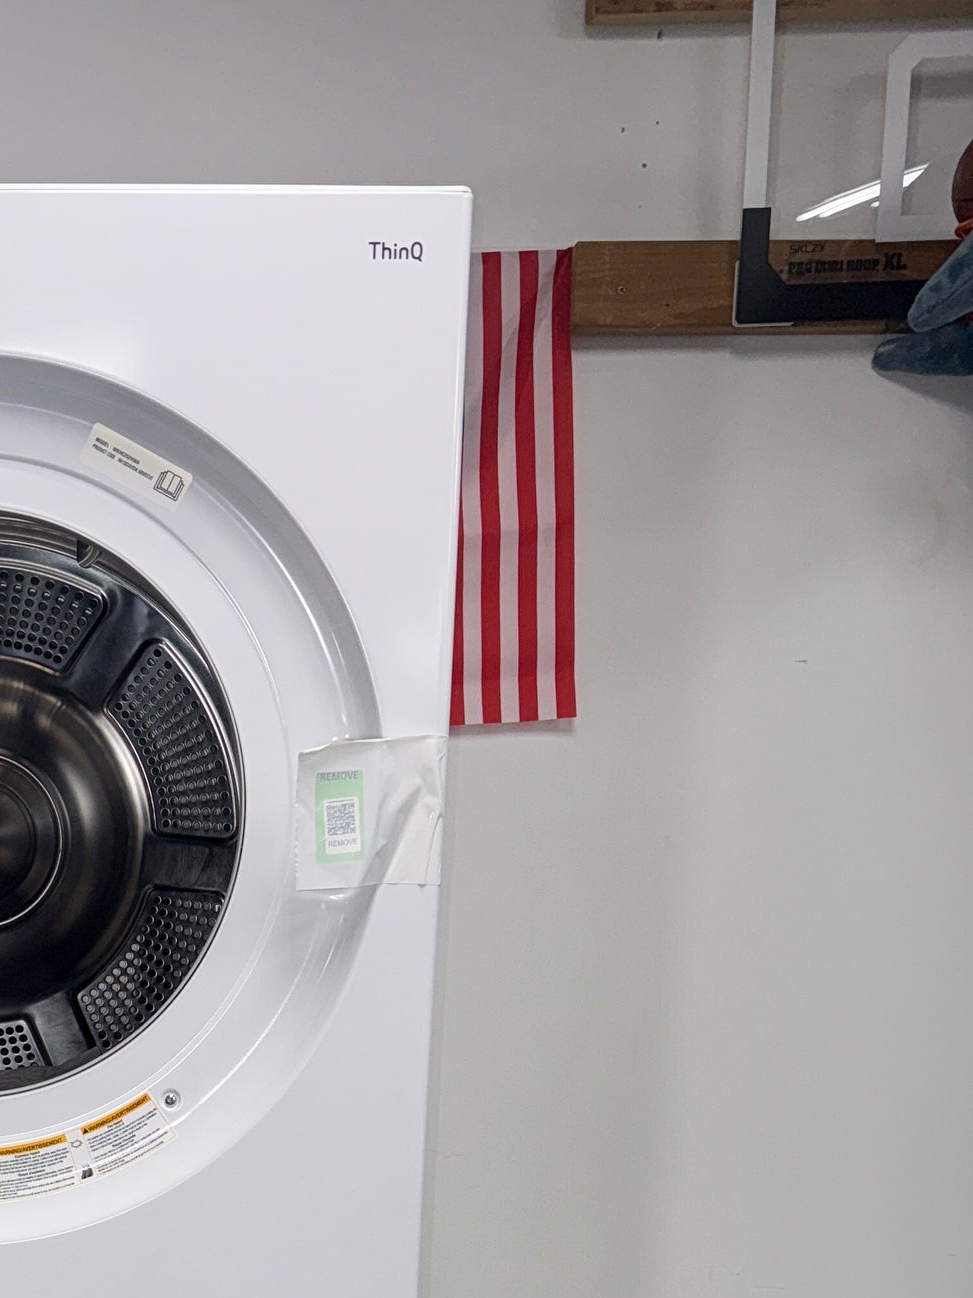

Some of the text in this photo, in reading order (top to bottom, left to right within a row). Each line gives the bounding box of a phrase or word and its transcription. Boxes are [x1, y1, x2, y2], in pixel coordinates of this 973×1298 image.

[368, 241, 424, 262] ThinQ
[882, 252, 908, 271] XL
[320, 770, 359, 781] REMOVE
[327, 839, 359, 848] REMOVE
